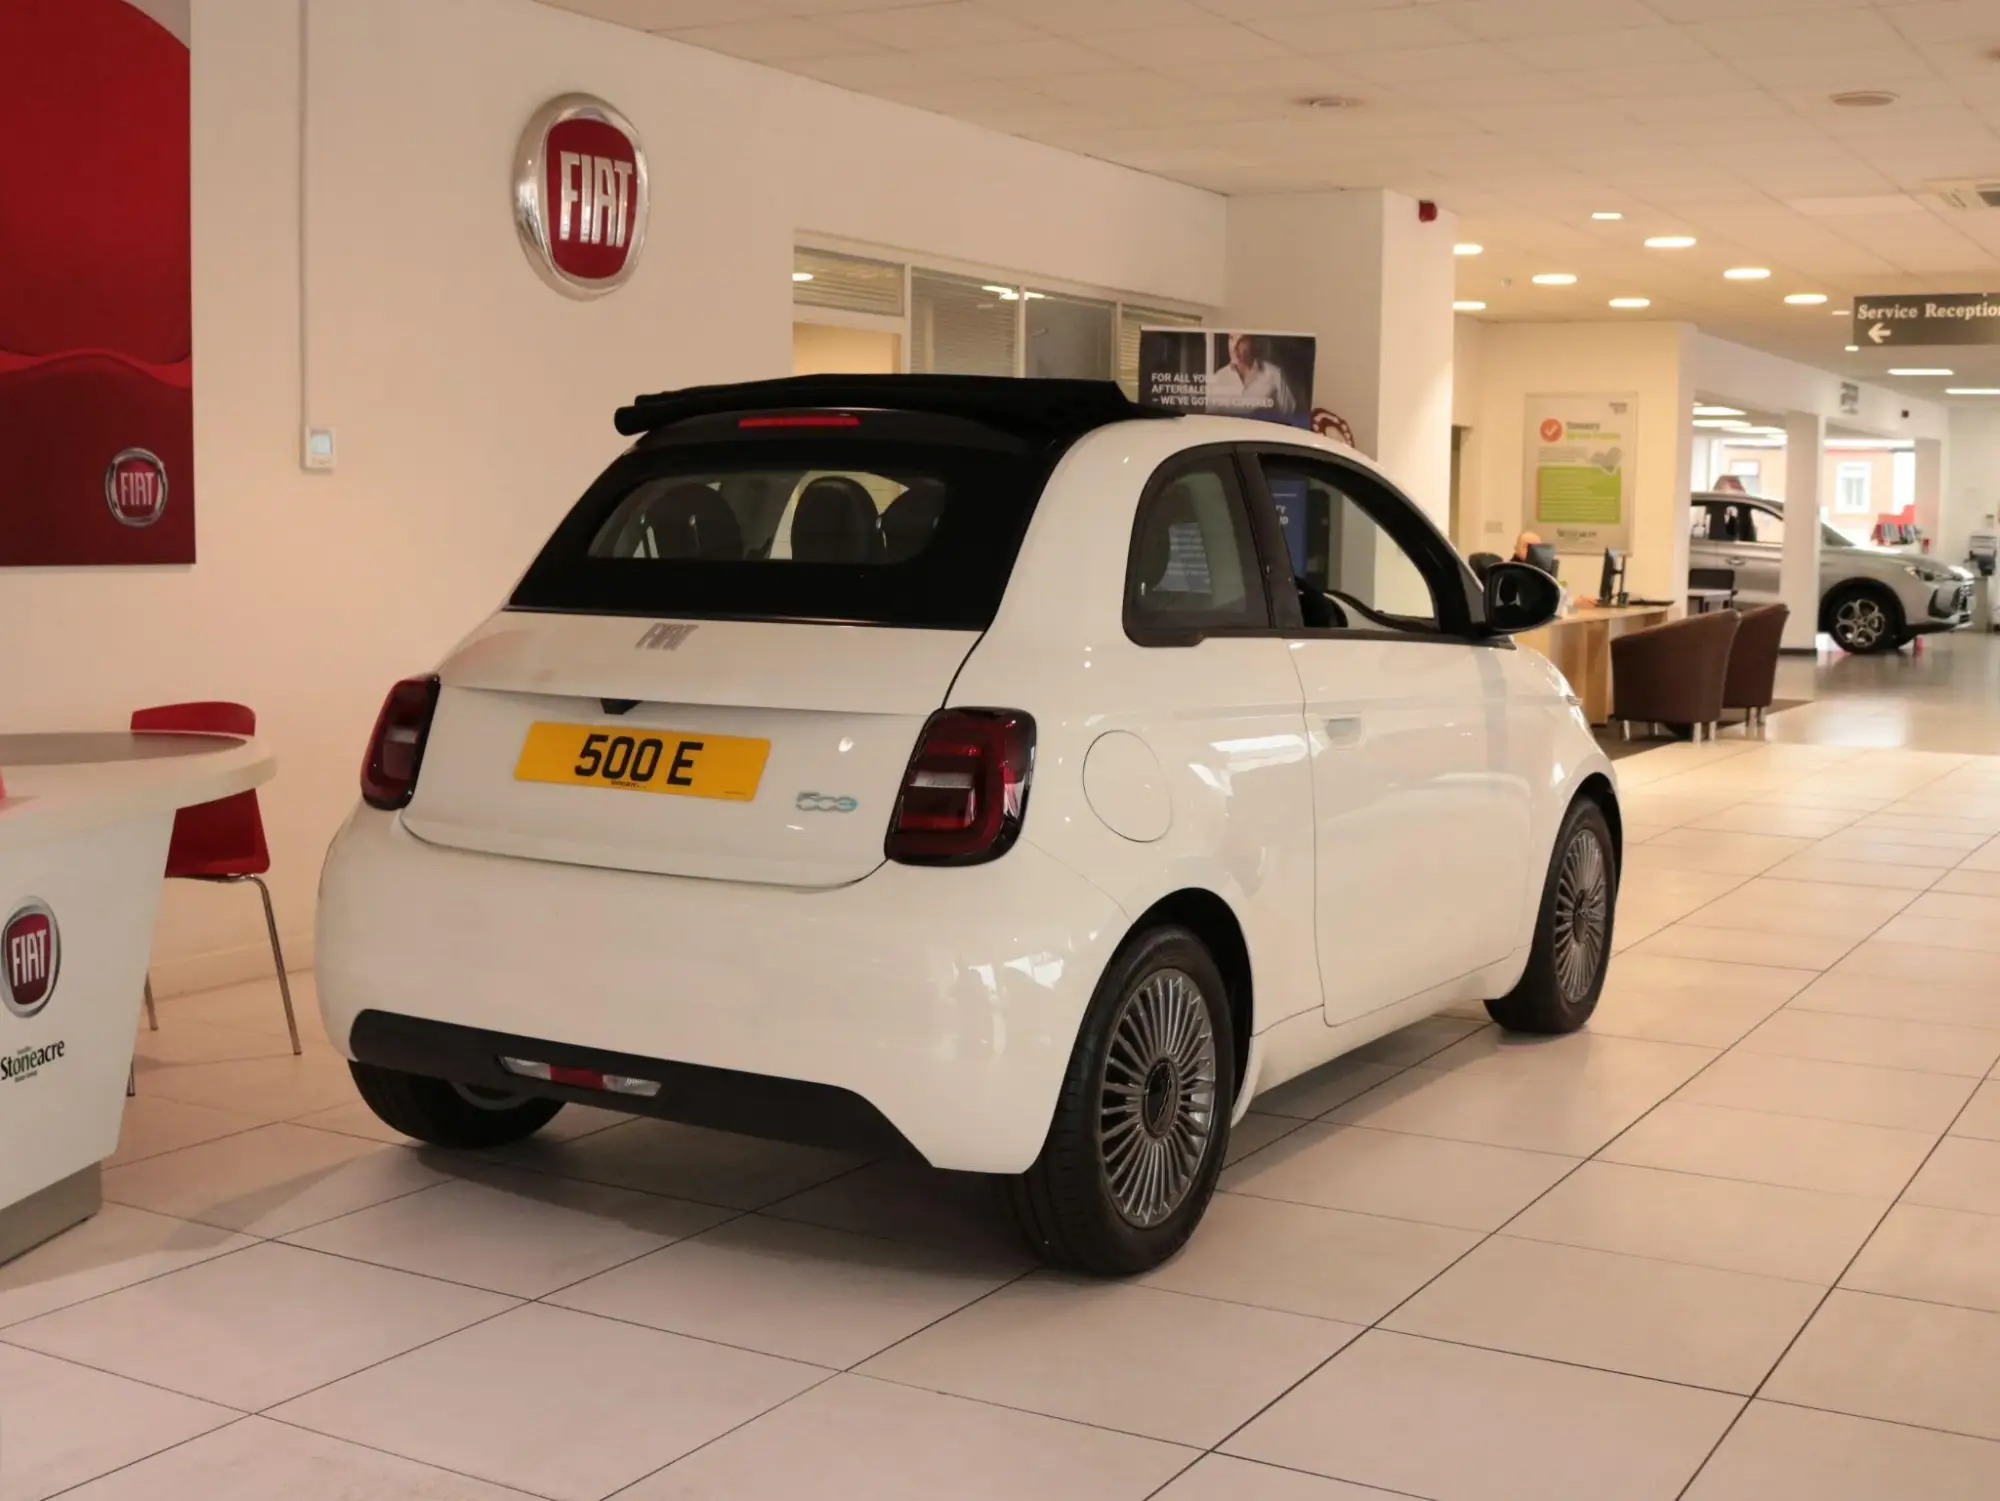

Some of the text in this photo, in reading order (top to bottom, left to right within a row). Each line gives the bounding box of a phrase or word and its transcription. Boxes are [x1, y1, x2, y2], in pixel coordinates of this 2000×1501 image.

[560, 150, 633, 248] FIAT
[1857, 301, 2000, 321] Service Receptio
[1151, 372, 1172, 382] FOR
[1173, 373, 1190, 383] ALL
[1151, 383, 1210, 394] AFTERSALE
[120, 471, 154, 506] FIAT
[575, 733, 704, 786] 500 E
[11, 928, 48, 987] FIAT
[1, 1040, 65, 1081] Stoneacre
